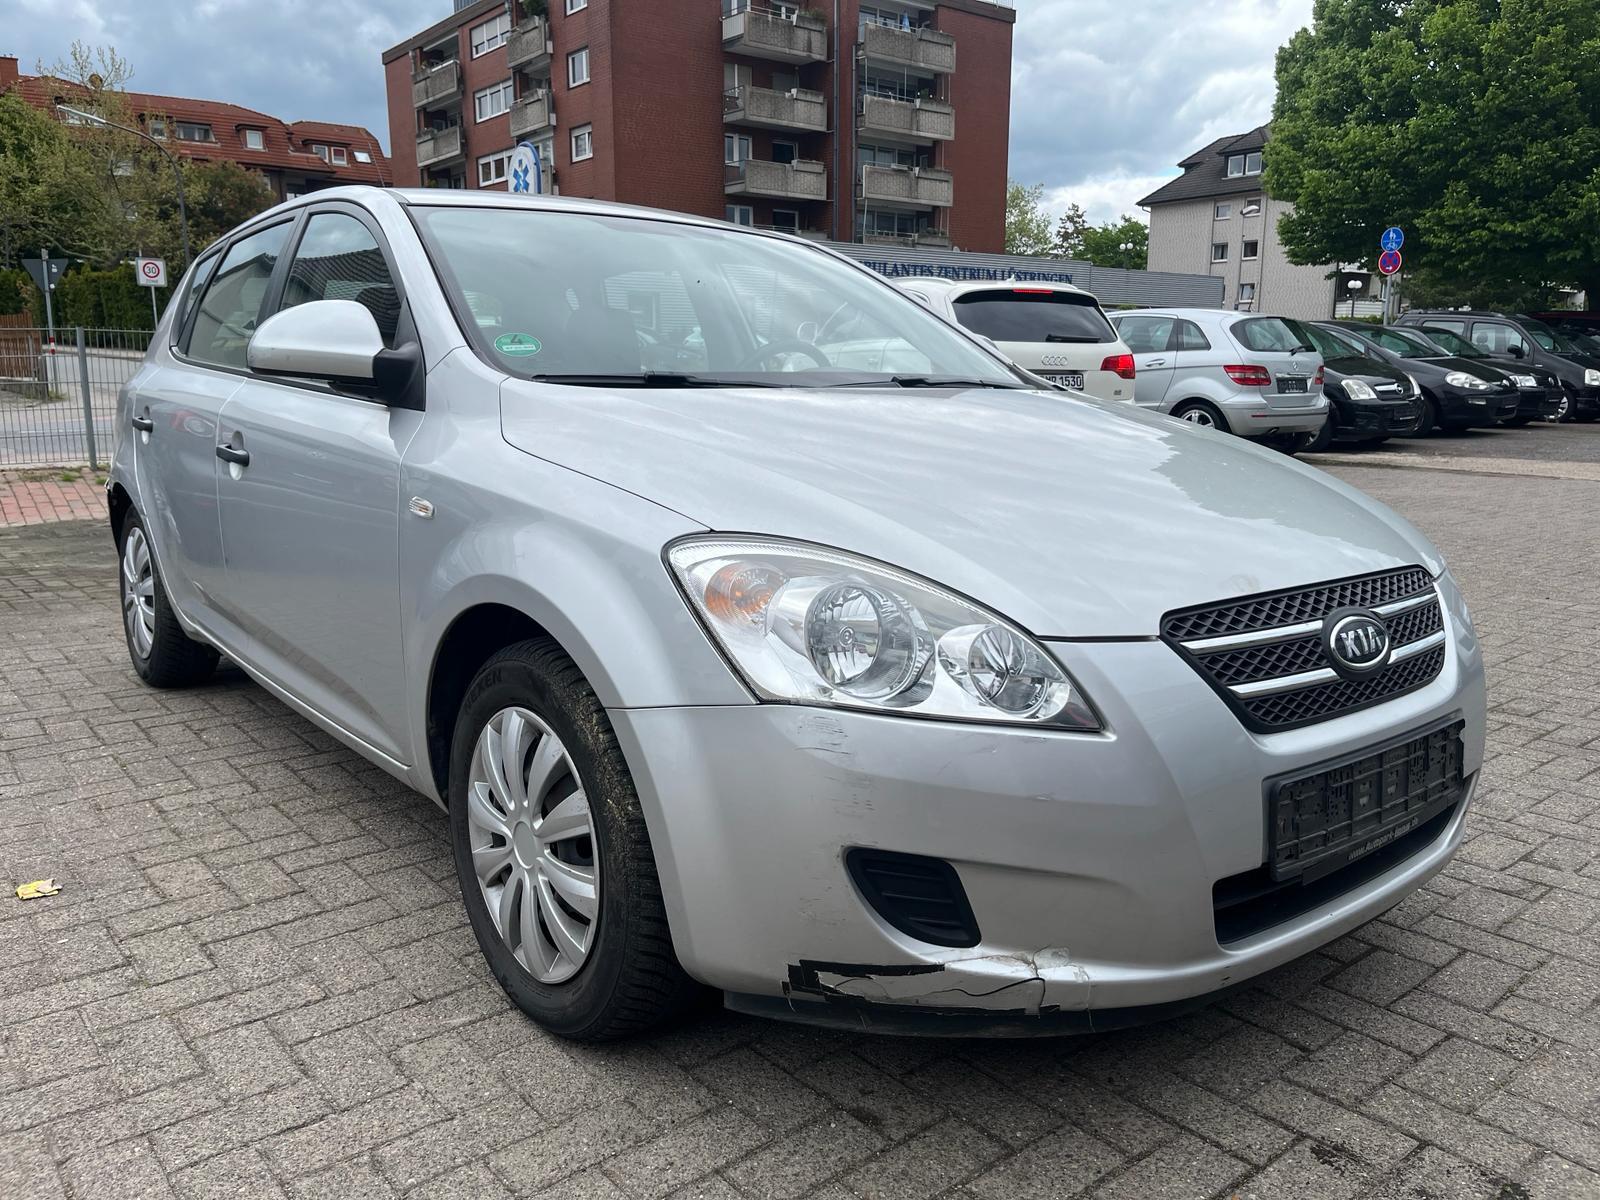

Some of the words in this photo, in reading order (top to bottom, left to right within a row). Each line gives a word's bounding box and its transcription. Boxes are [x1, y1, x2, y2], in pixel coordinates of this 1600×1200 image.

[146, 266, 156, 274] 30
[936, 266, 997, 281] ZENTRUM
[1000, 266, 1073, 284] LÜSTRINGEN
[511, 333, 522, 344] 4
[1060, 375, 1082, 387] 1530
[1340, 626, 1383, 659] KIA
